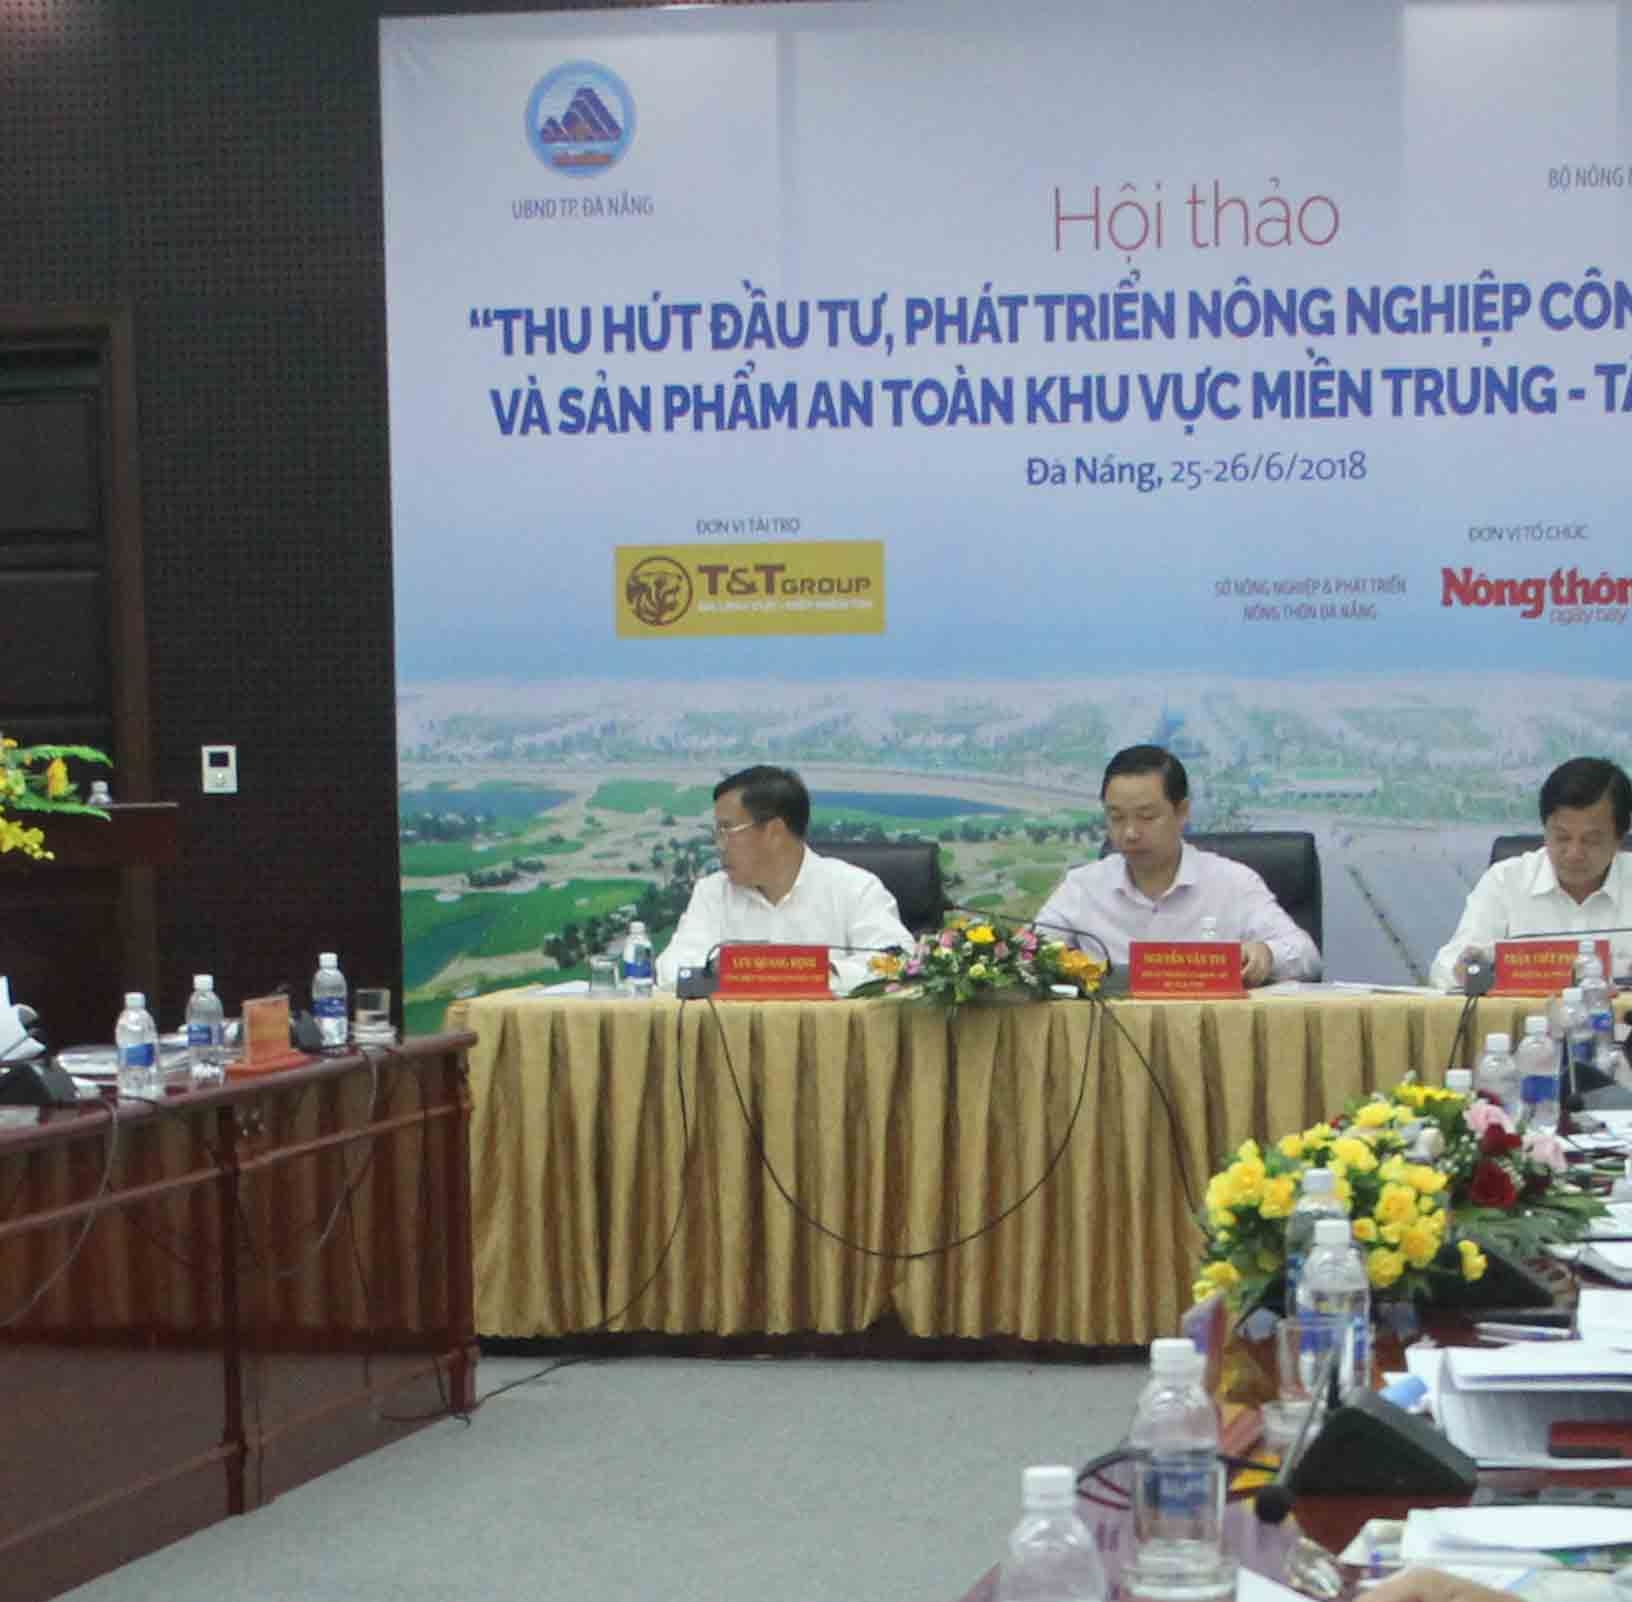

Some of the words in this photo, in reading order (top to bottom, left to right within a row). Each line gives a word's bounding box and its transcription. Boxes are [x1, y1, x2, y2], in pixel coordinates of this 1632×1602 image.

[1574, 162, 1624, 188] NÔNG
[1054, 179, 1164, 265] Hội
[1184, 175, 1340, 250] thảo
[603, 290, 703, 353] HÚT
[709, 279, 810, 350] ĐẦU
[817, 291, 895, 357] TƯ,
[904, 281, 1029, 346] PHÁT
[1033, 269, 1176, 342] TRIỂN
[1188, 275, 1335, 340] NÔNG
[1346, 269, 1533, 348] NGHIỆP
[488, 374, 552, 437] VÀ
[557, 368, 653, 436] SẢN
[663, 360, 799, 432] PHẨM
[806, 378, 874, 431] AN
[881, 363, 1015, 428] TOÀN
[1025, 373, 1131, 426] KHU
[1137, 365, 1242, 436] VỰC
[1251, 346, 1373, 421] MIỀN
[1380, 363, 1558, 418] TRUNG
[1567, 386, 1587, 402] -
[1025, 455, 1067, 488] Đà
[1169, 450, 1368, 492] 25-26/6/2018
[697, 562, 786, 596] T&T
[781, 576, 872, 596] GROUP
[1440, 566, 1547, 620] Nông
